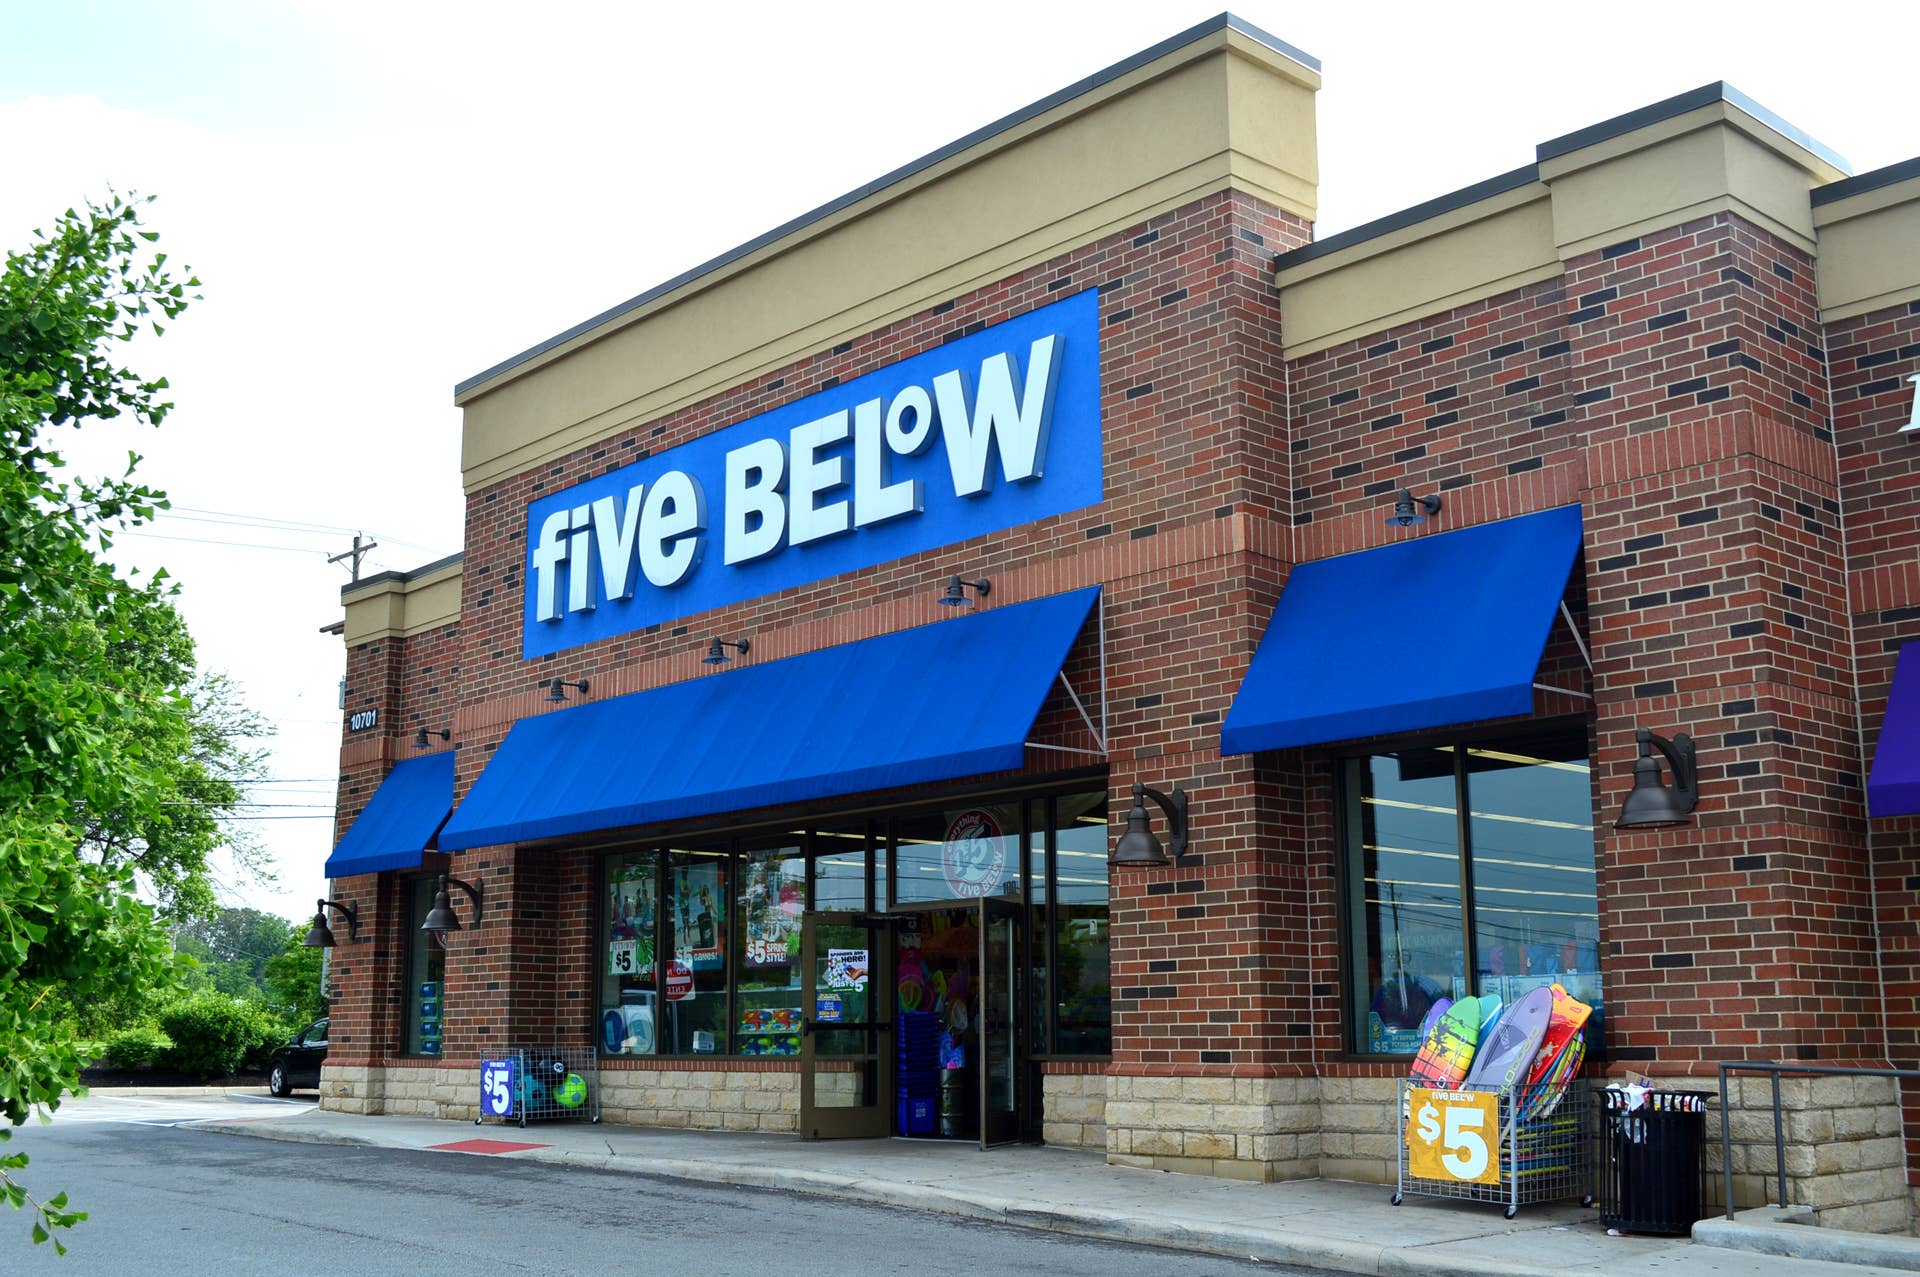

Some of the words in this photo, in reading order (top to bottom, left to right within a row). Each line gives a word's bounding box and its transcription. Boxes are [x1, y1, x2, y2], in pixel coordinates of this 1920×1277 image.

[532, 470, 707, 623] five
[350, 709, 376, 731] 10701
[615, 951, 631, 972] $5
[747, 940, 766, 964] $5
[1374, 1041, 1389, 1053] $5
[483, 1068, 510, 1114] $5
[1416, 1101, 1489, 1180] $5
